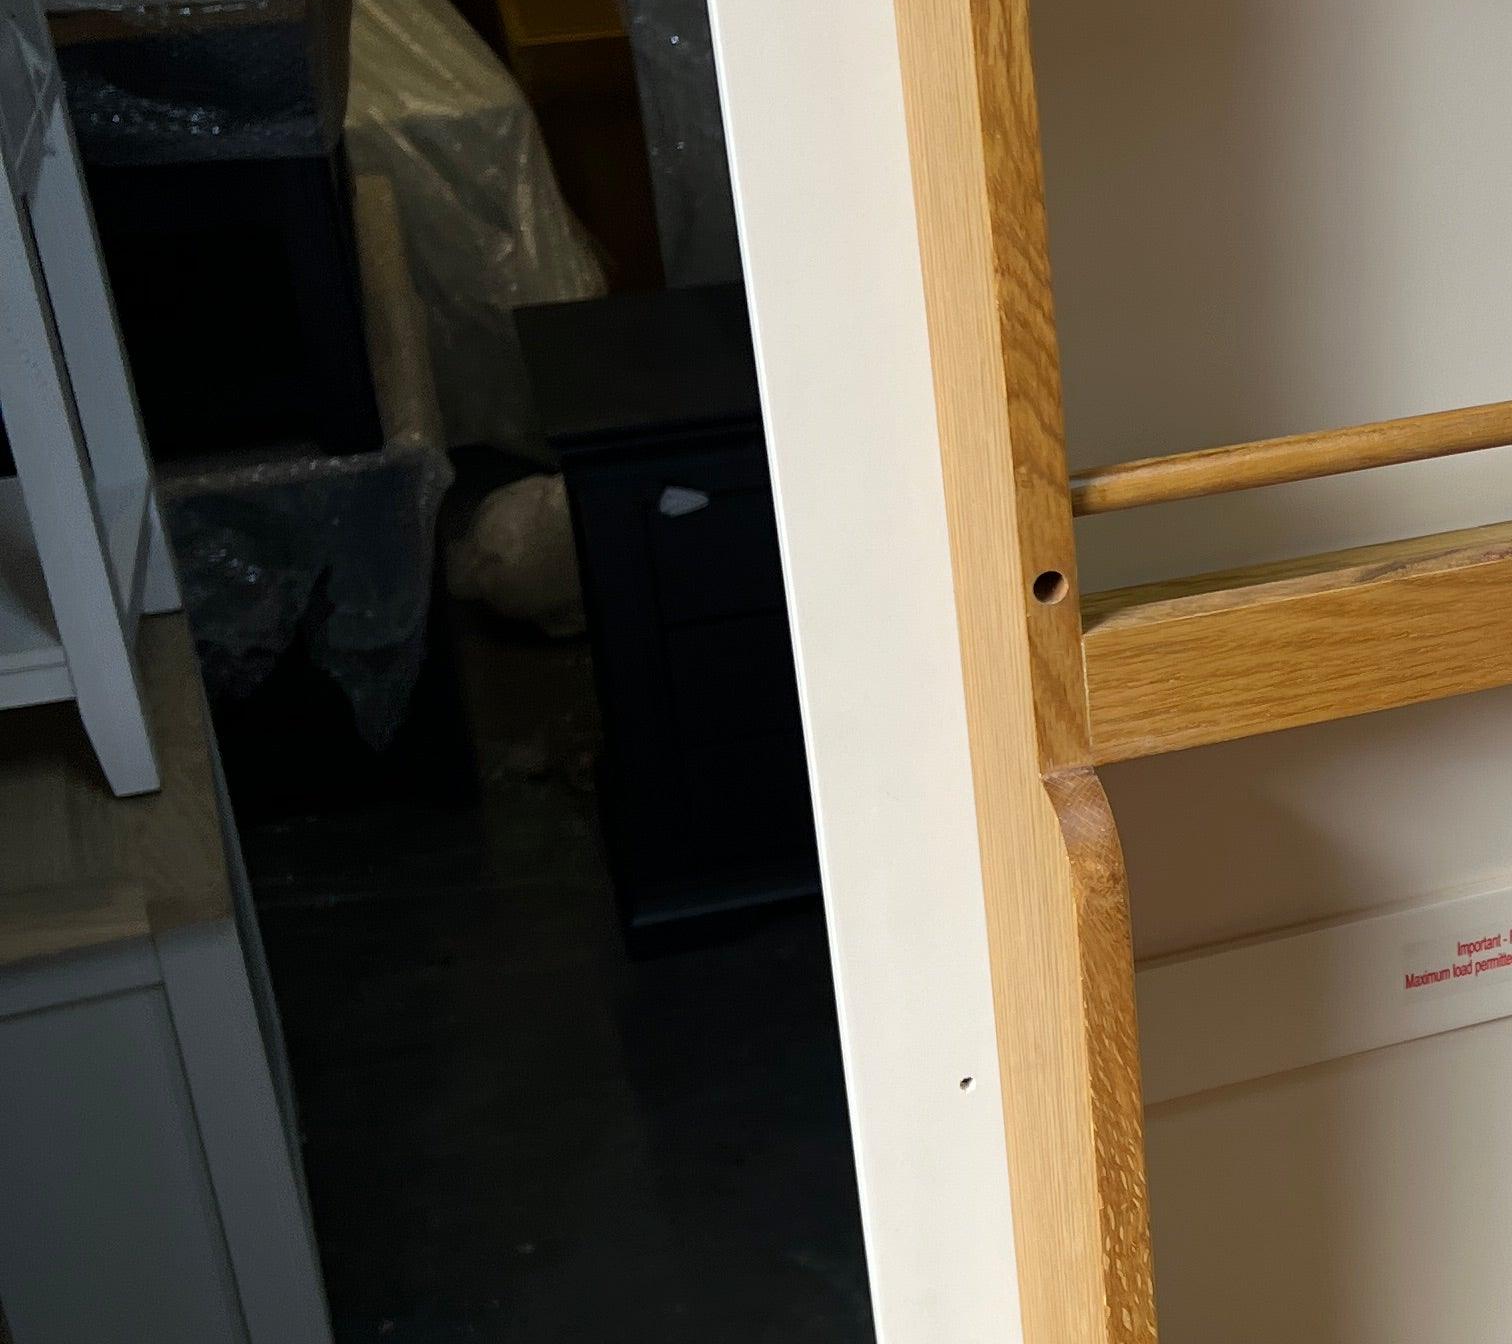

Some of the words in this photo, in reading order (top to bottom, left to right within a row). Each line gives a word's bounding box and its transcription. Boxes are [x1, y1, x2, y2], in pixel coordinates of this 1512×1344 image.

[1457, 934, 1501, 956] Important
[1405, 968, 1450, 990] Maximum
[1452, 960, 1473, 977] load
